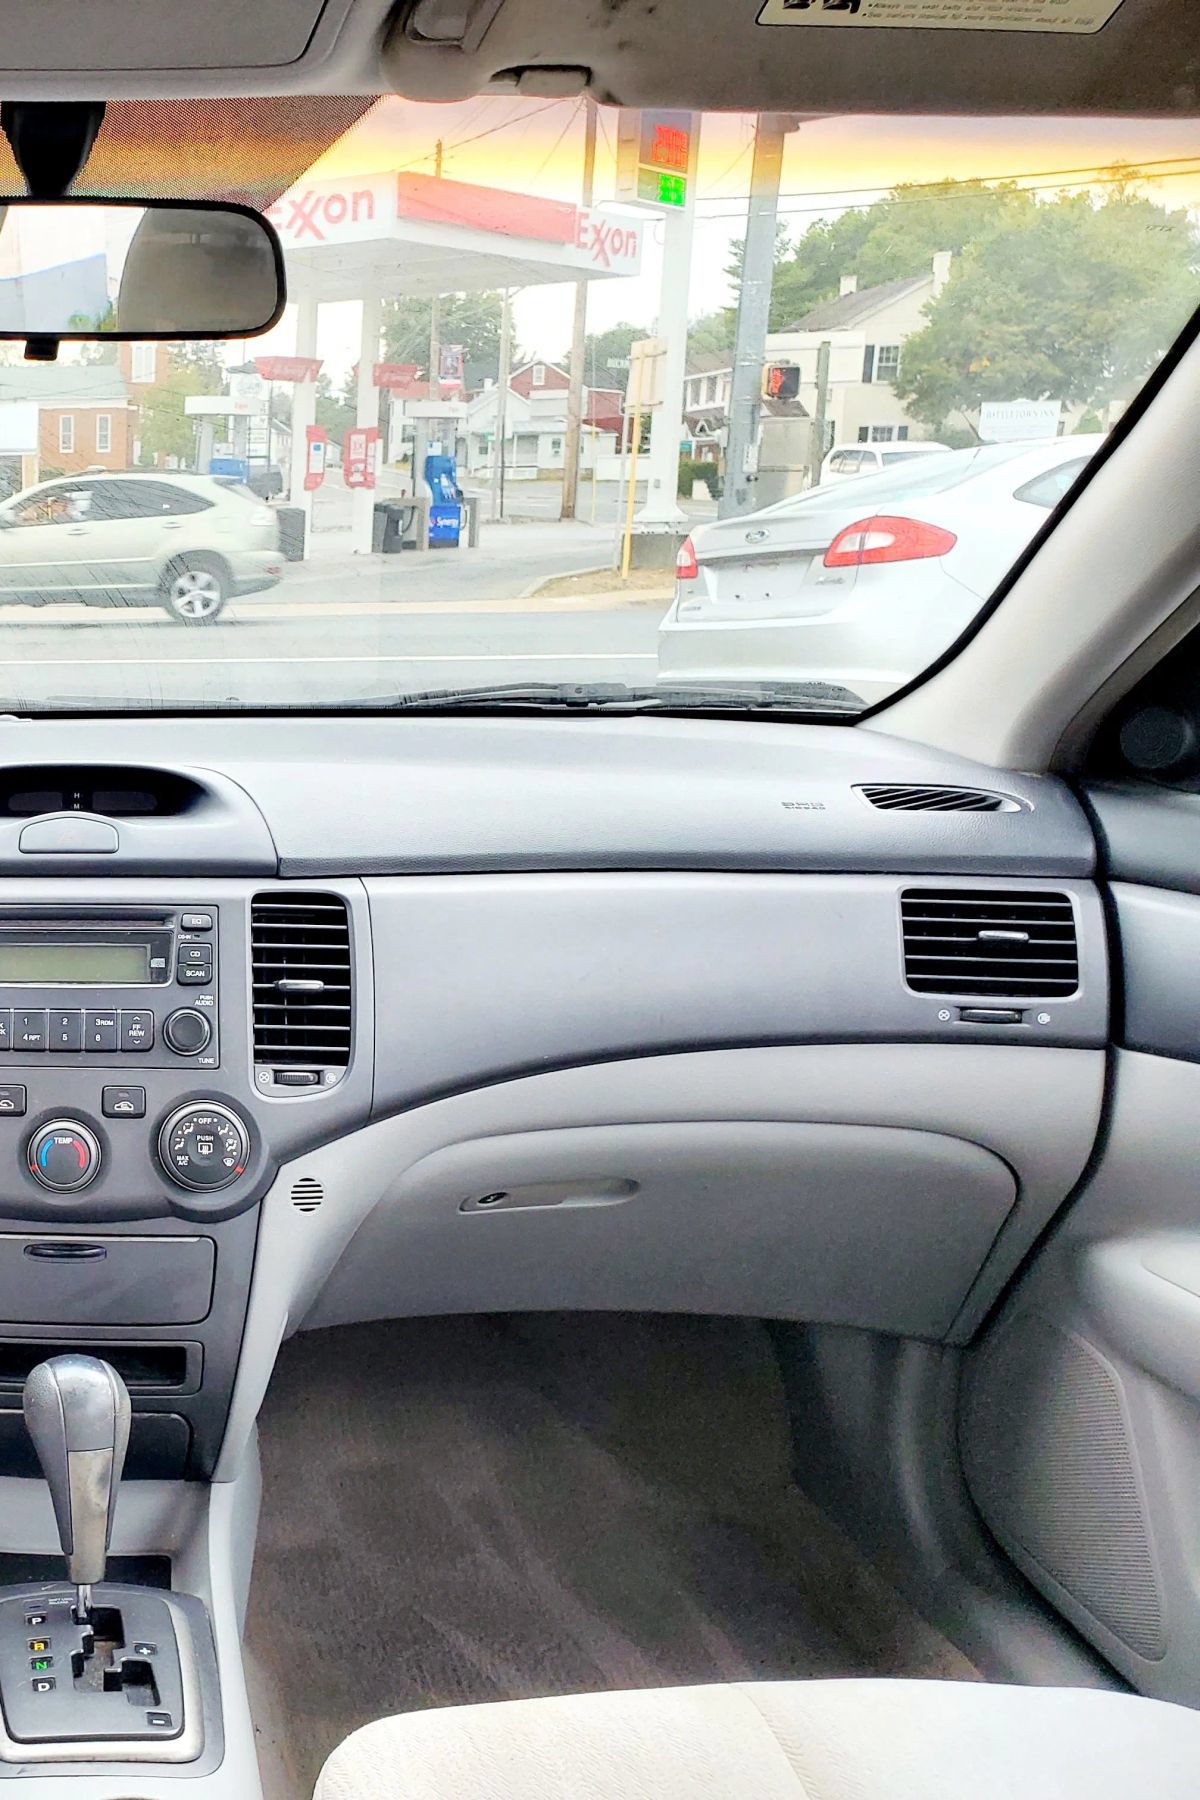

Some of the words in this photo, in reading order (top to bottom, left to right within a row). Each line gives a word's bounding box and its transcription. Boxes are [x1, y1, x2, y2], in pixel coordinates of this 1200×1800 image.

[95, 1034, 101, 1042] 6
[54, 1136, 72, 1145] TEMP
[32, 1617, 42, 1625] P
[34, 1642, 44, 1651] R
[35, 1661, 47, 1670] N
[38, 1682, 50, 1692] D
